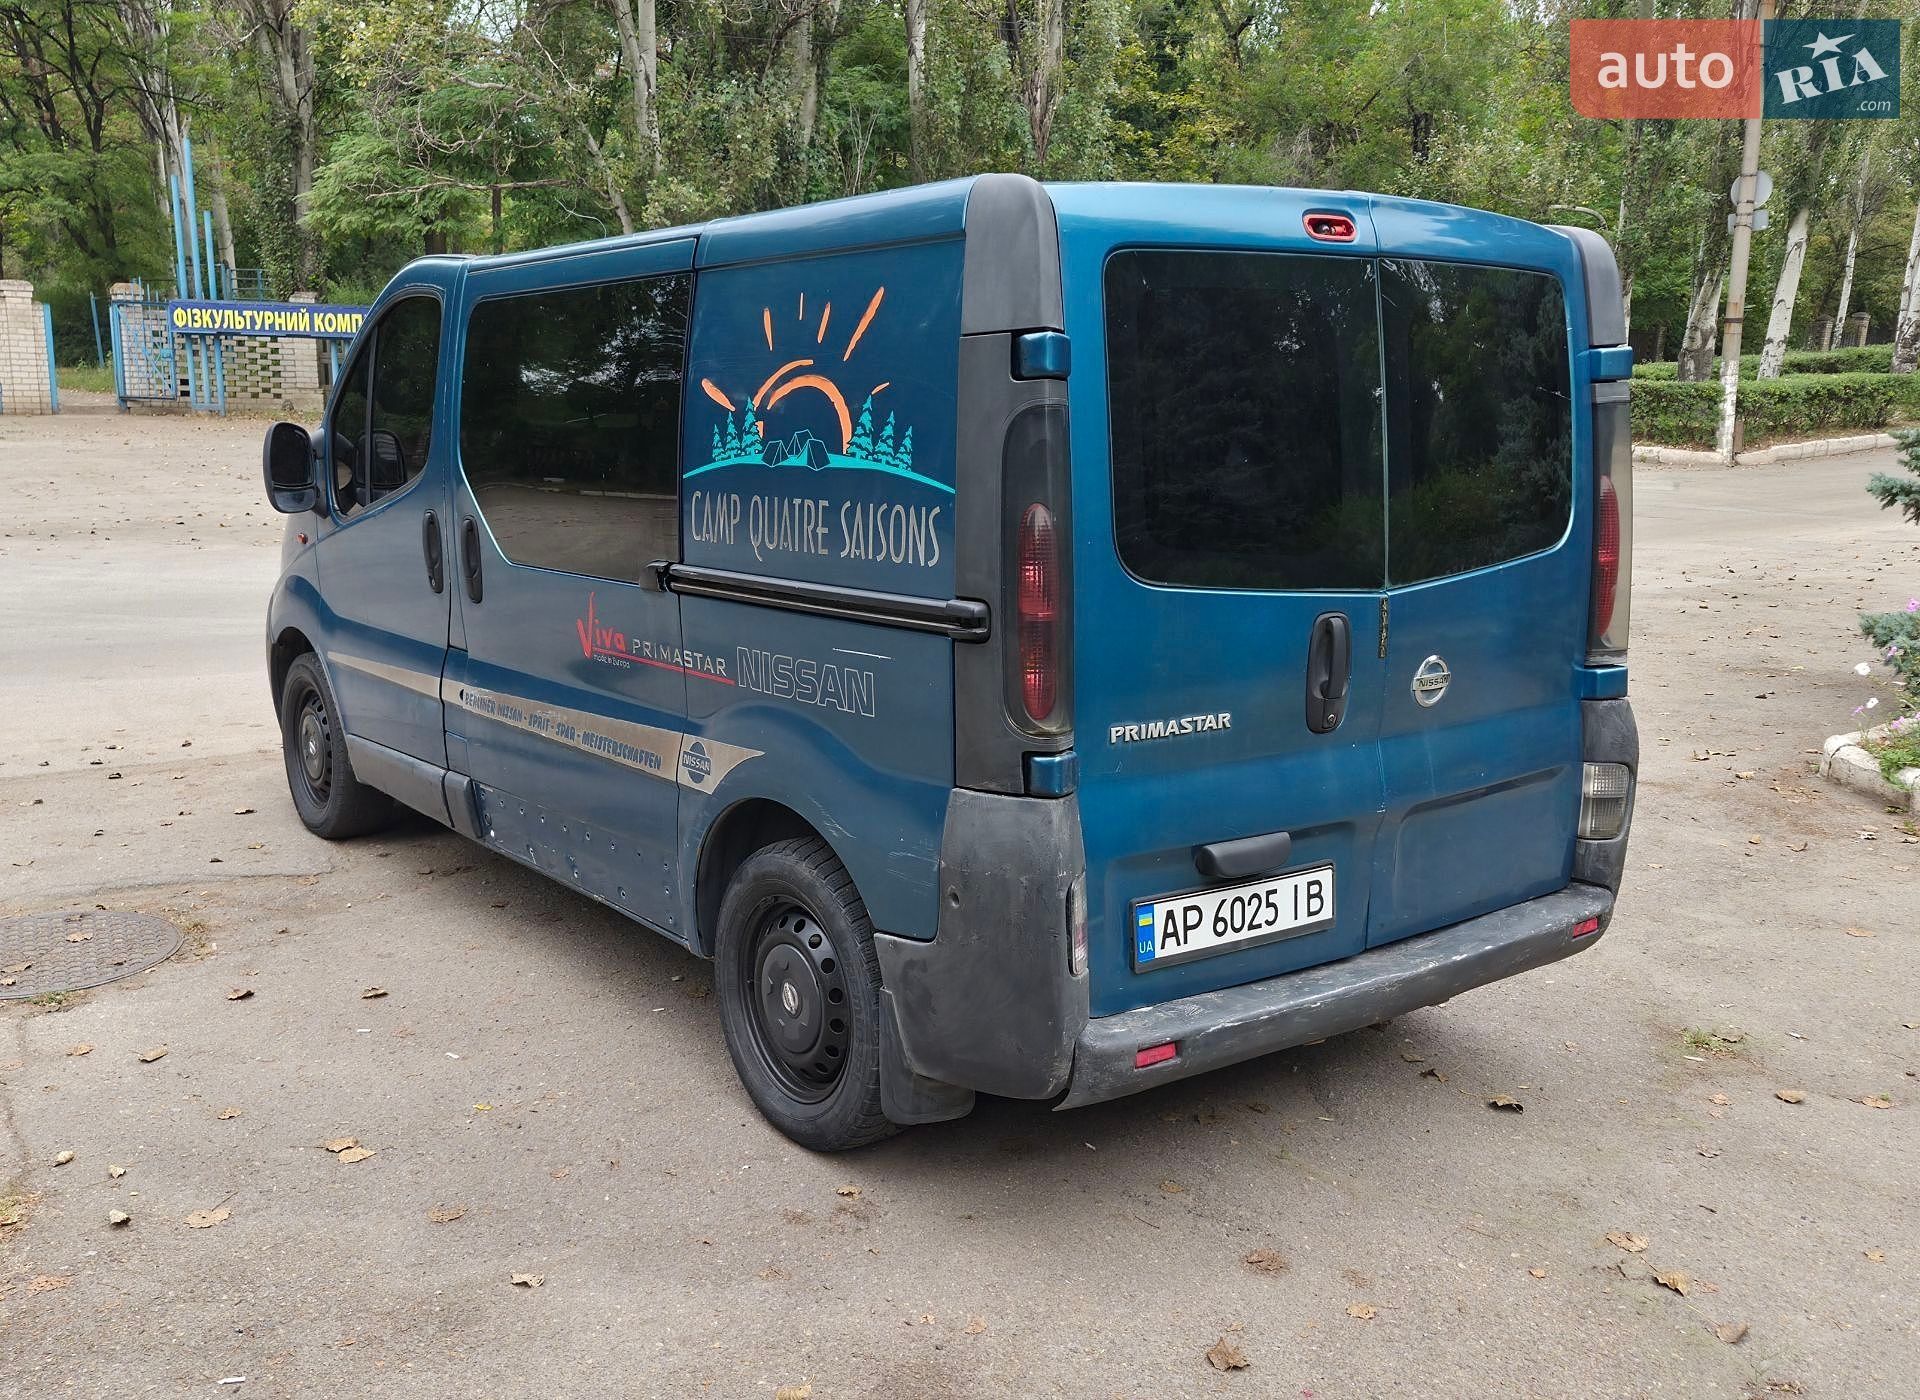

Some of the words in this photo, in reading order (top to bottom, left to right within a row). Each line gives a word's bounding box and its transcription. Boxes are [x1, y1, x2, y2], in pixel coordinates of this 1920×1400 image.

[173, 307, 310, 332] ФІЗКУЛЬТУРНИЙ
[314, 312, 366, 333] КОМП
[691, 490, 741, 545] CAMP
[750, 494, 829, 562] QUATRE
[840, 501, 941, 567] SAISONS
[576, 592, 626, 659] Viva
[632, 639, 727, 677] PRIMASTAR
[737, 646, 875, 718] NISSAN
[1418, 674, 1450, 687] NISSAN
[1110, 711, 1231, 744] PRIMASTAR
[683, 754, 711, 772] NISSAN
[1160, 904, 1203, 949] AP
[1212, 888, 1279, 938] 6025
[1139, 940, 1154, 954] UA
